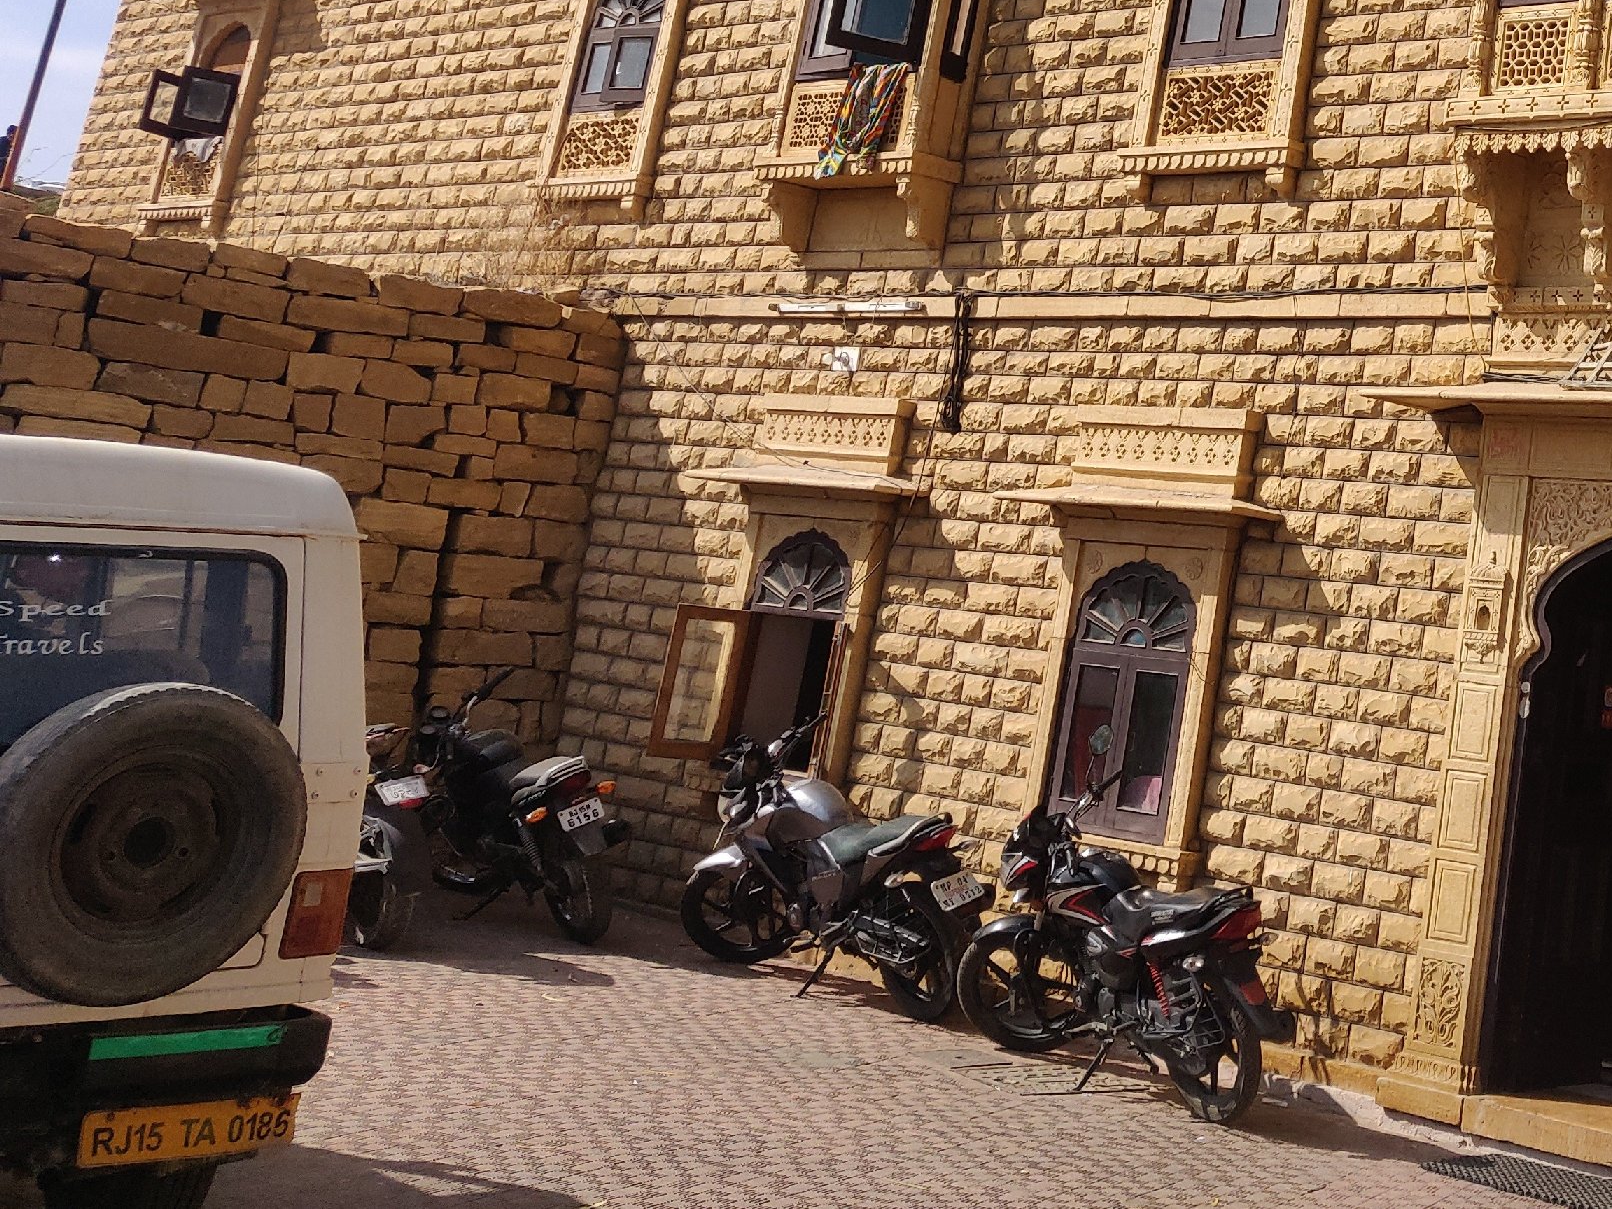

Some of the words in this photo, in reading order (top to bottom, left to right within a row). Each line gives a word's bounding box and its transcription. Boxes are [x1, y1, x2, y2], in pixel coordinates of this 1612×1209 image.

[0, 599, 114, 622] Speed
[91, 1121, 164, 1157] RJ15
[180, 1116, 216, 1148] TA
